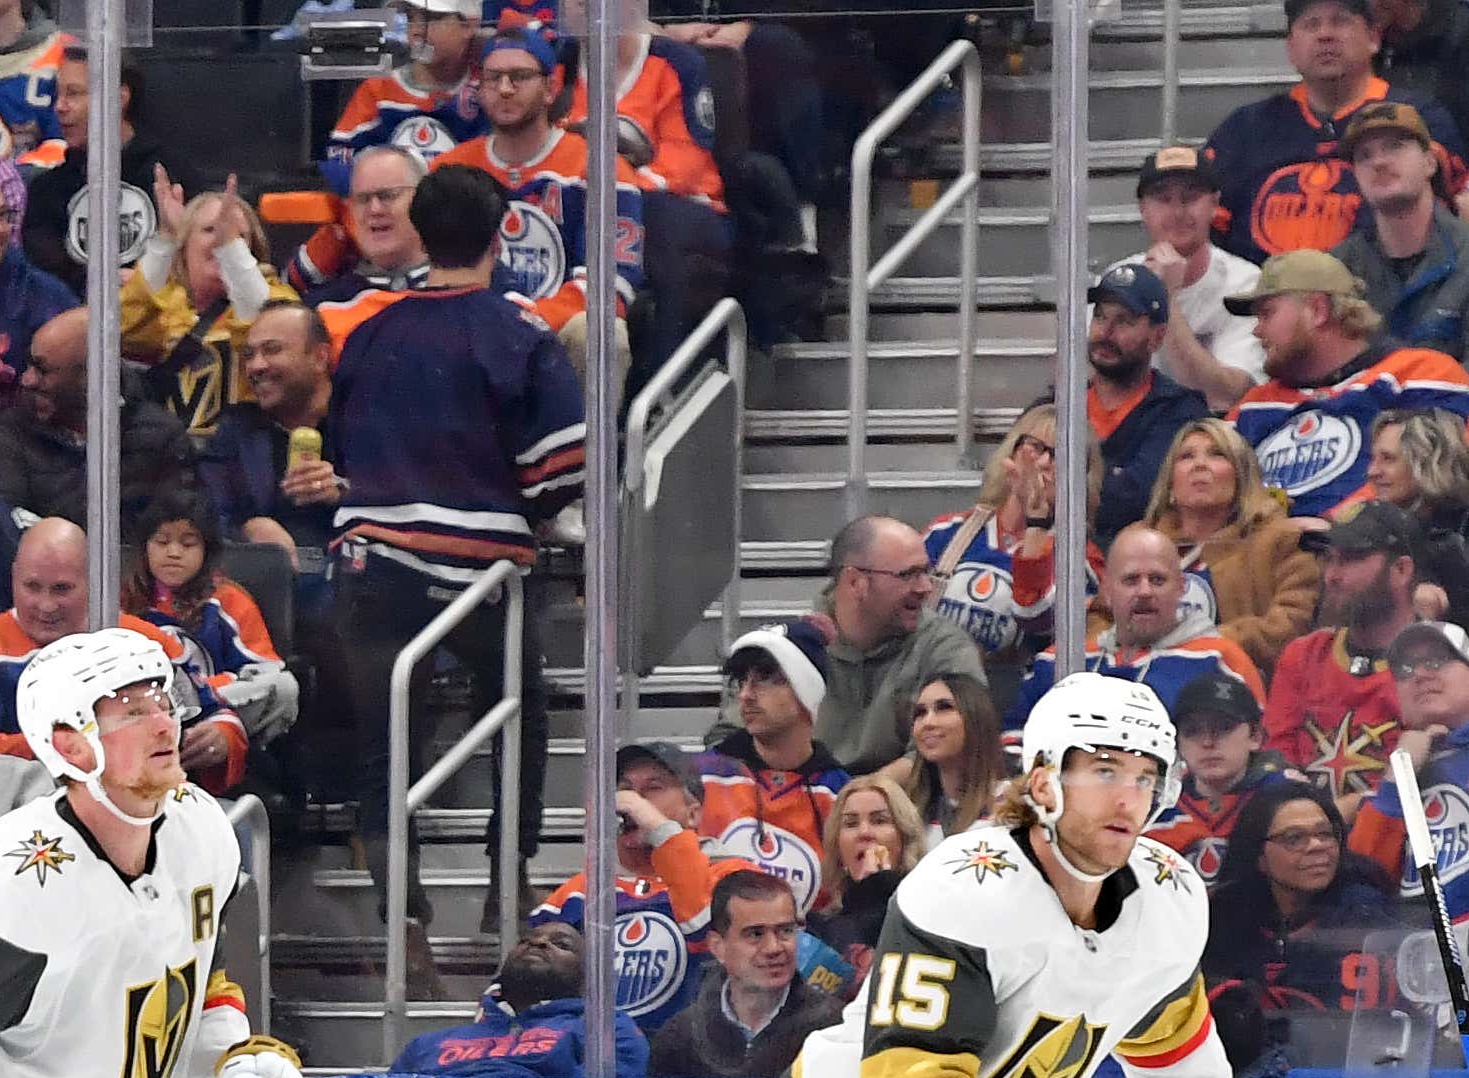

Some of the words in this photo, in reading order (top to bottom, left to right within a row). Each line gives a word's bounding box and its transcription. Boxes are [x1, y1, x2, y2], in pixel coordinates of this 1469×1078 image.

[25, 70, 55, 107] C
[1262, 436, 1340, 478] OILERS
[1120, 715, 1162, 730] CCM
[191, 883, 213, 943] A
[870, 952, 957, 1031] 15
